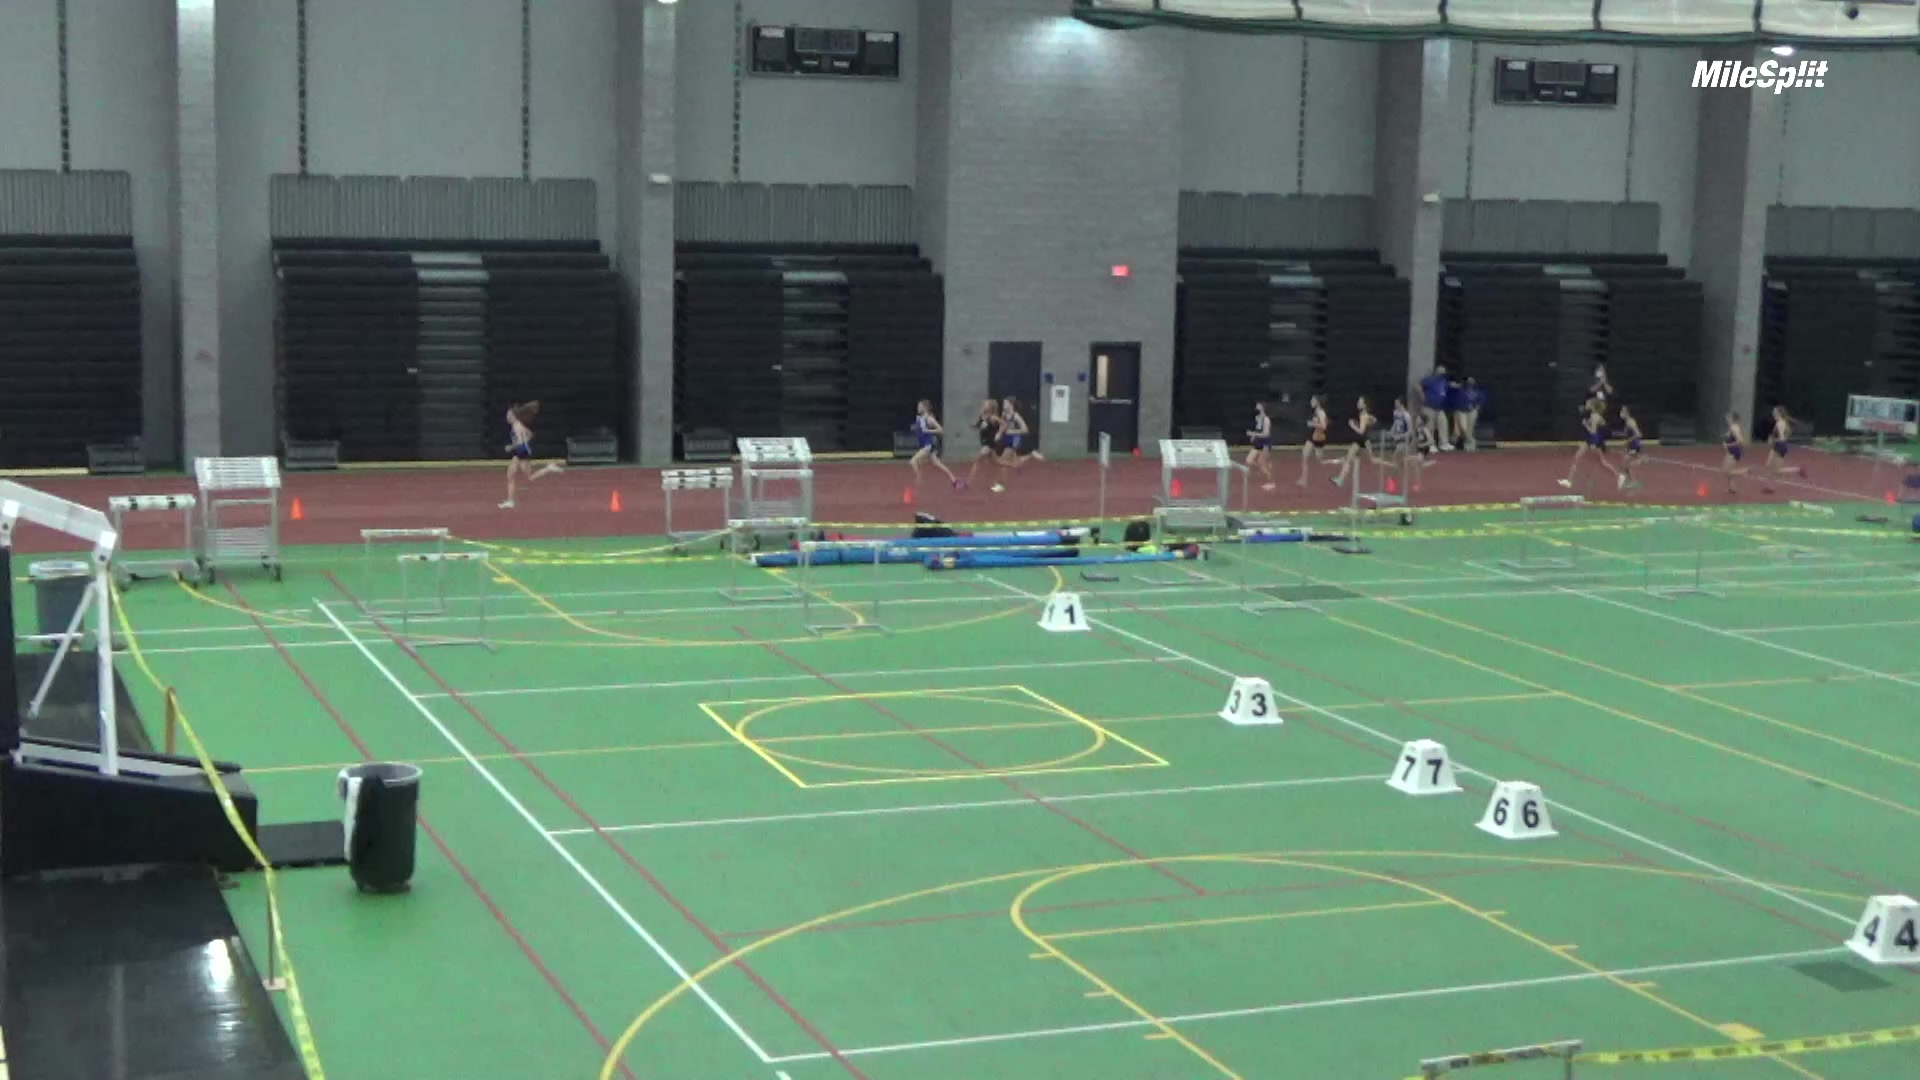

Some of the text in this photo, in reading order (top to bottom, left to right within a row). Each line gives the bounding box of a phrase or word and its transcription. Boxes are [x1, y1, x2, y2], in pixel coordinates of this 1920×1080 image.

[1064, 603, 1075, 625] 1
[1251, 693, 1267, 717] 3
[1401, 755, 1416, 782] 7
[1427, 759, 1443, 785] 7
[1493, 797, 1509, 826] 6
[1522, 800, 1539, 828] 6
[1863, 915, 1880, 947] 4
[1894, 918, 1918, 952] 4
